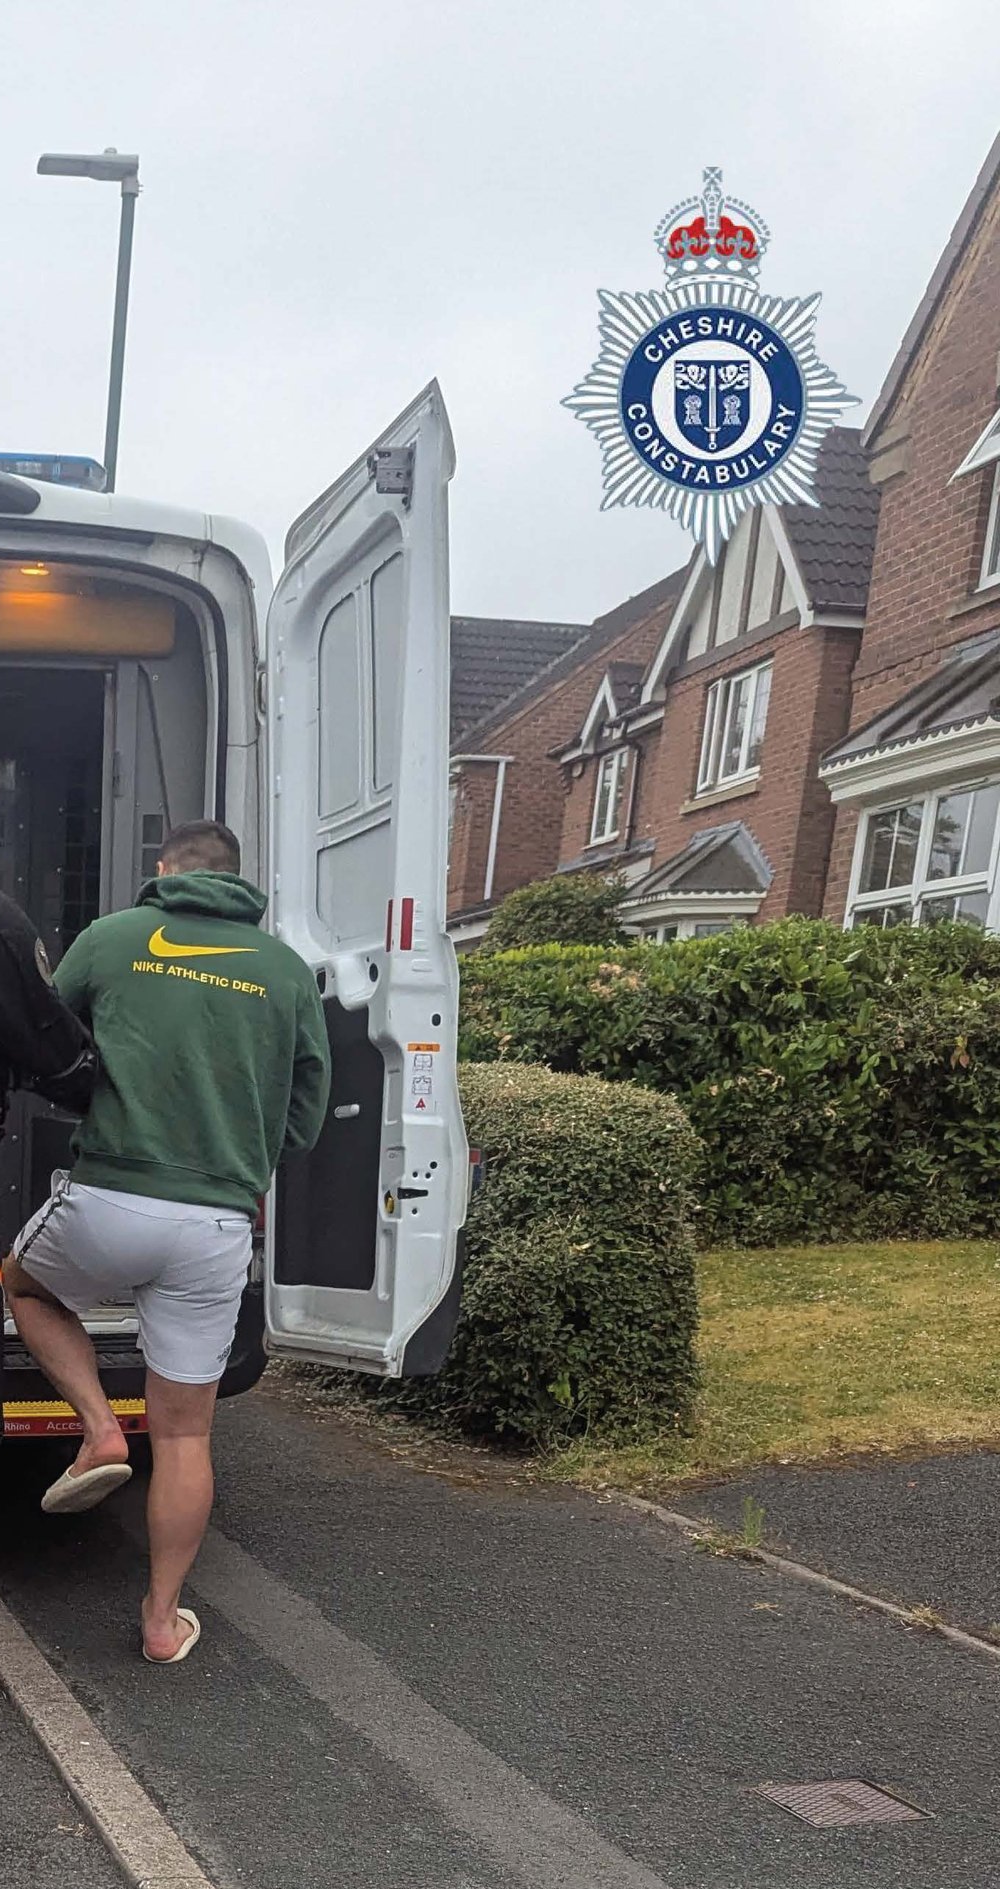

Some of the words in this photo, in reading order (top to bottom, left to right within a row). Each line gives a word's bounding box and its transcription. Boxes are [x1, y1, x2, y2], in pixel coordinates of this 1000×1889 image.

[132, 961, 164, 974] NIKE
[166, 965, 229, 988] ATHLETIC
[232, 980, 267, 998] DEPT.
[4, 1421, 31, 1432] Rhino
